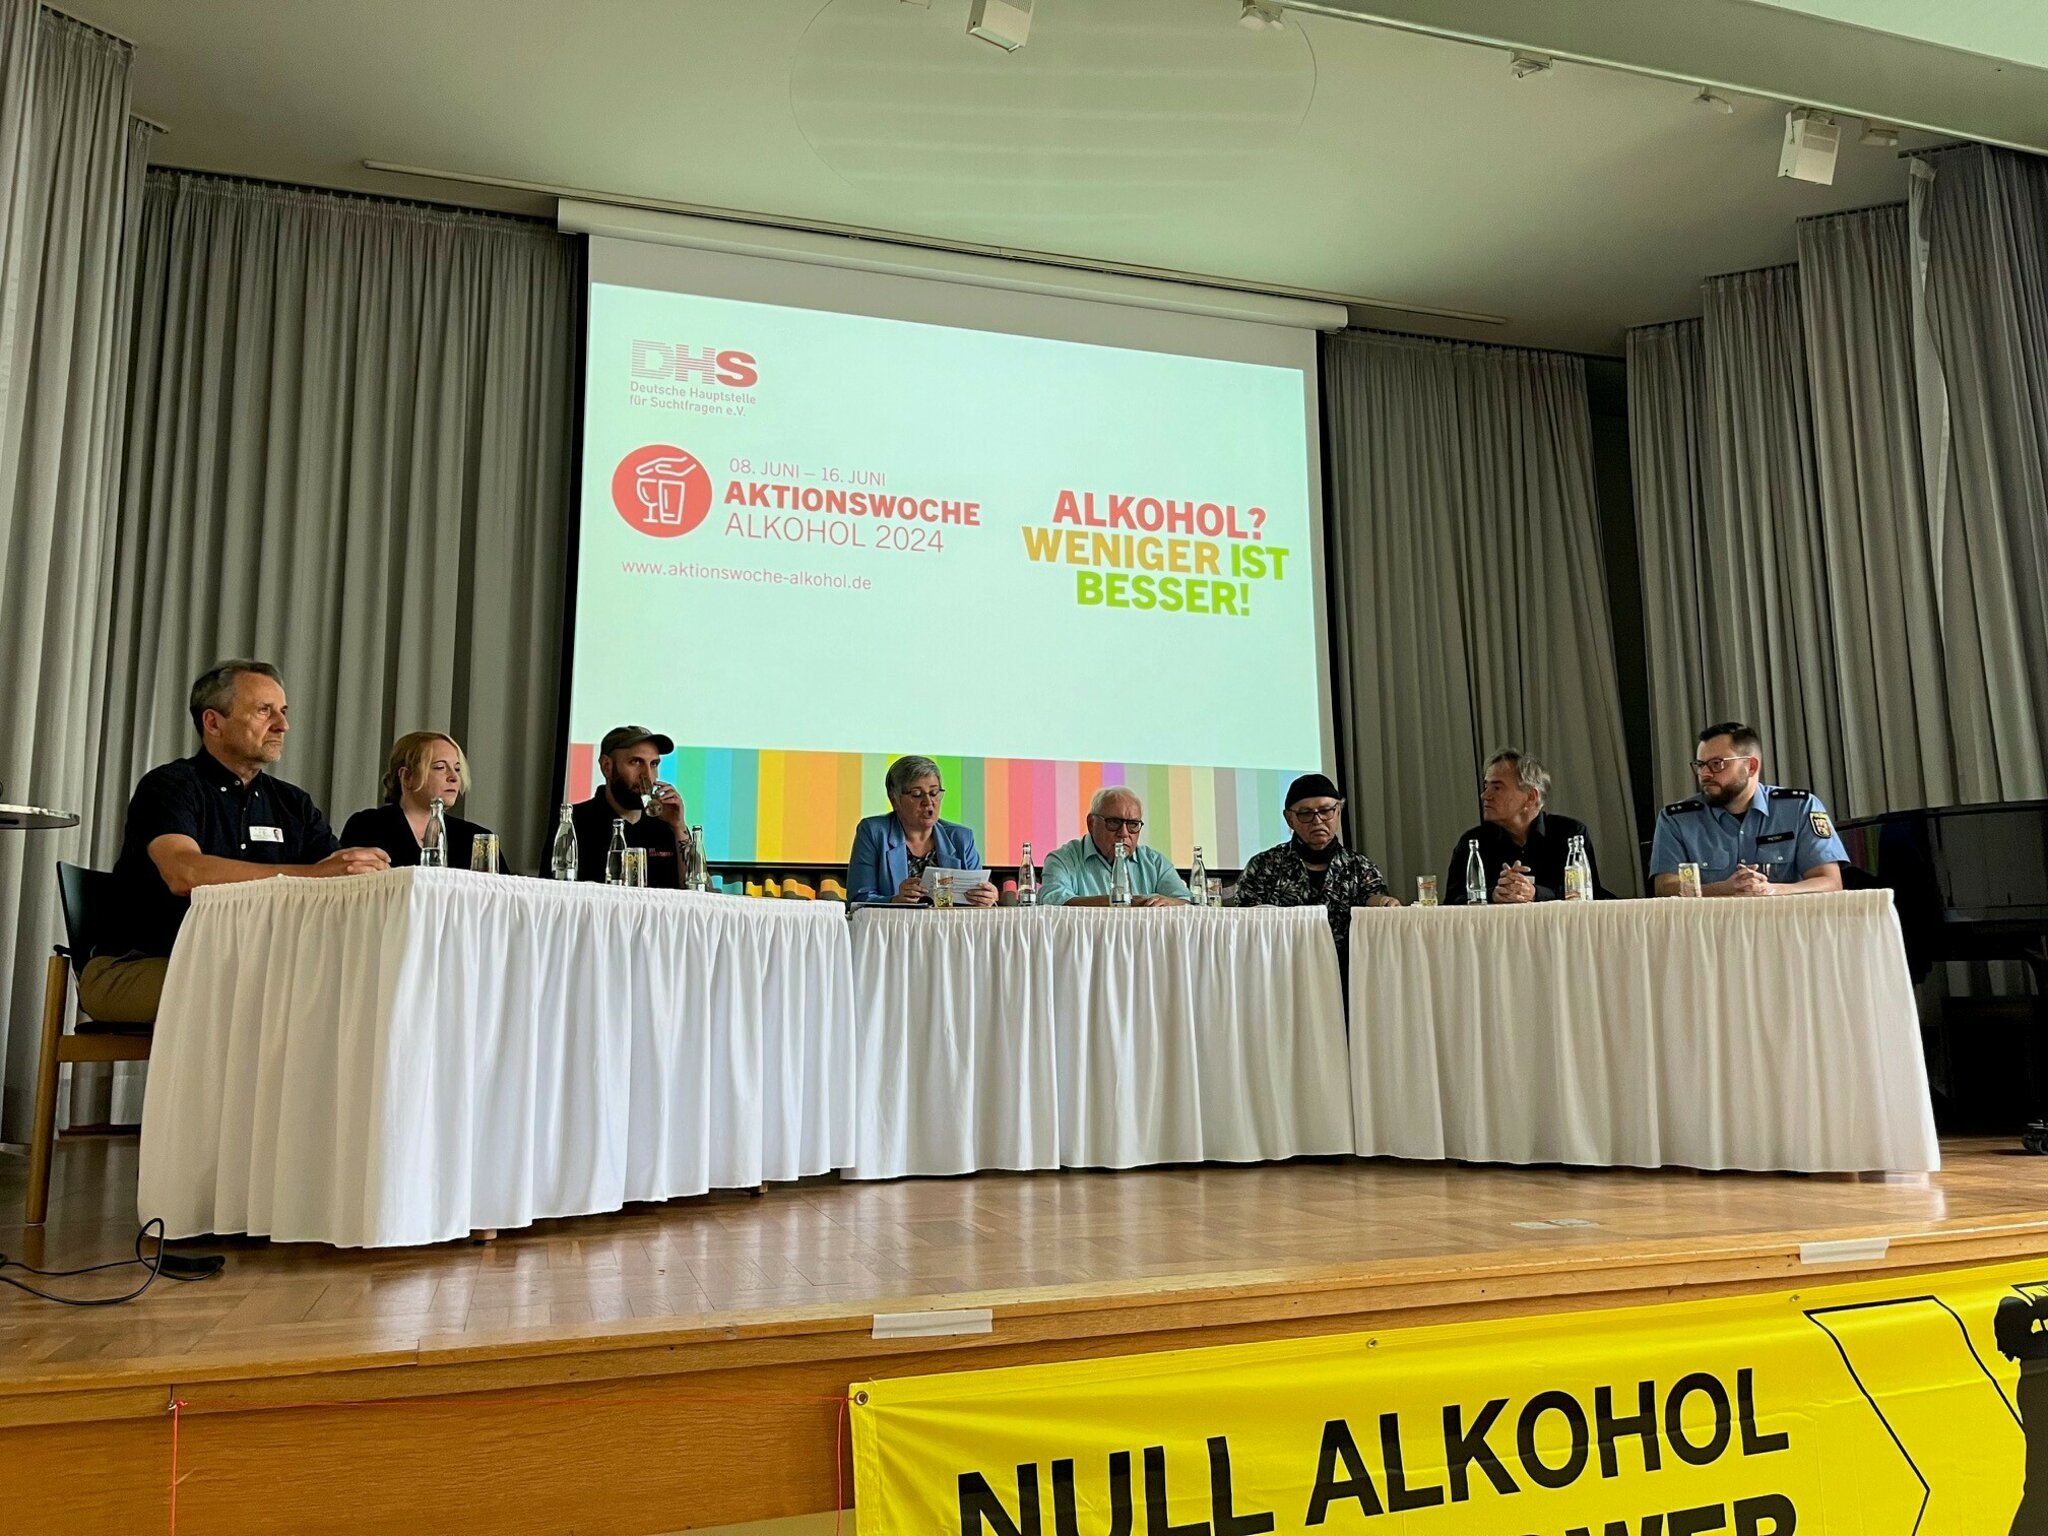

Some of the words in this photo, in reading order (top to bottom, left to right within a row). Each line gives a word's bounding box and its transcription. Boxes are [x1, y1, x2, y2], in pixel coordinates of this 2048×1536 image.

[631, 339, 758, 388] DHS
[629, 394, 647, 406] für
[650, 396, 723, 415] Suchtfragen
[726, 405, 746, 417] e.V.
[630, 380, 687, 397] Deutsche
[689, 387, 757, 405] Hauptstelle
[729, 457, 756, 475] 08.
[760, 459, 800, 479] JUNI
[821, 466, 844, 483] 16.
[848, 468, 886, 487] JUNI
[723, 480, 981, 526] AKTIONSWOCHE
[1052, 489, 1267, 540] ALKOHOL?
[724, 512, 867, 548] ALKOHOL
[874, 524, 945, 553] 2024
[1021, 526, 1222, 576] WENIGER
[1230, 543, 1290, 580] IST
[620, 560, 872, 591] www.aktionswoche-alkohol.de
[1076, 570, 1250, 616] BESSER!
[957, 1435, 1275, 1536] NULL
[1305, 1367, 1790, 1526] ALKOHOL
